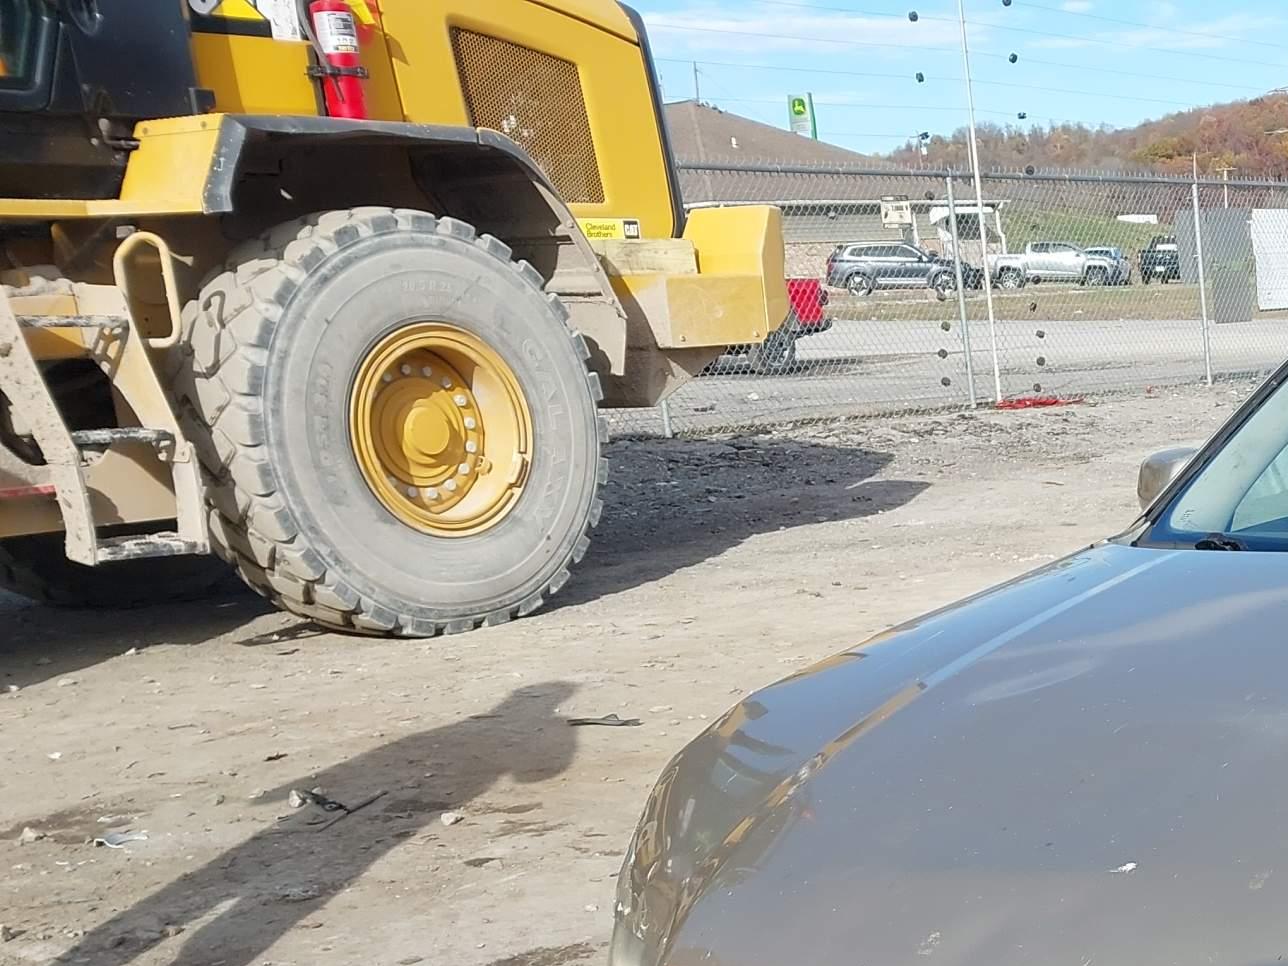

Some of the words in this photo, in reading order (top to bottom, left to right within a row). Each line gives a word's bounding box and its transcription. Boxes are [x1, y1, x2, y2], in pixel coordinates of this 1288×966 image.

[585, 223, 616, 231] Cleveland
[624, 224, 639, 236] CAT
[586, 230, 613, 238] Brothers
